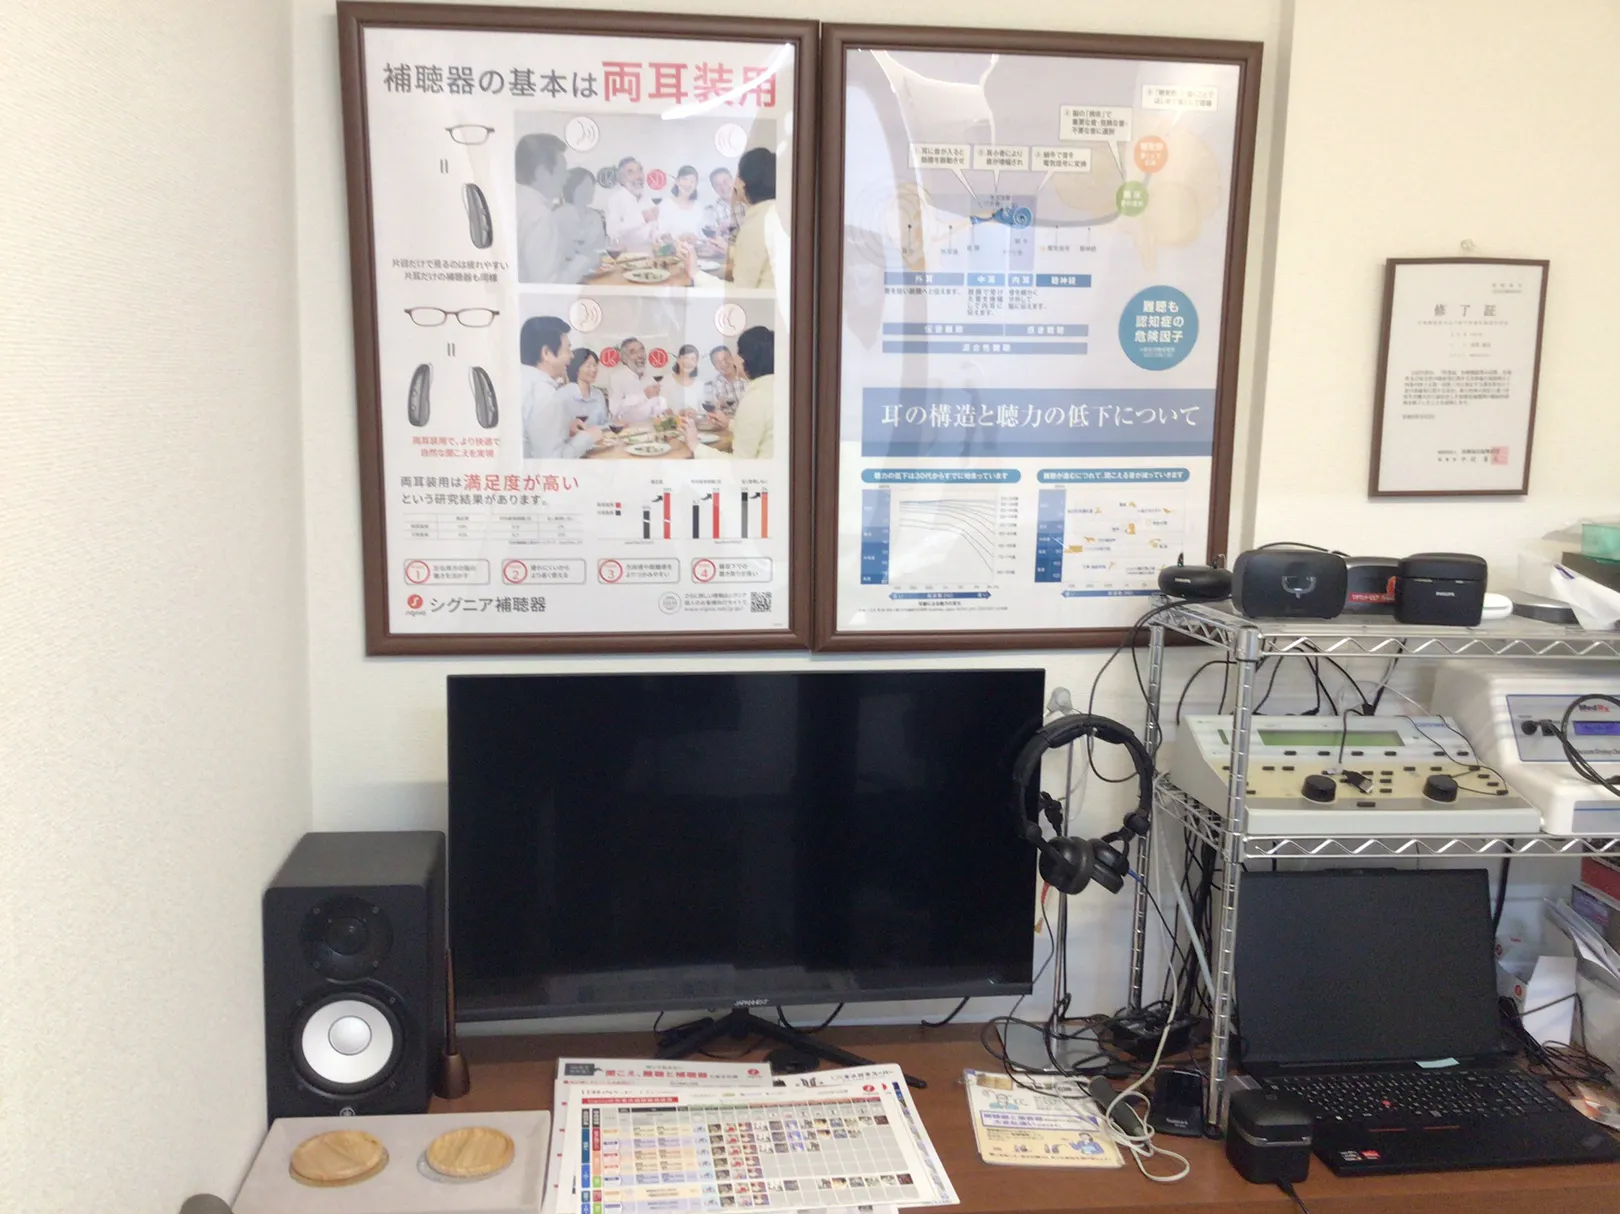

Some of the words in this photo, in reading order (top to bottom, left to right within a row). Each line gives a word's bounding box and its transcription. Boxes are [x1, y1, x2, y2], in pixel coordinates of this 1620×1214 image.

[383, 61, 777, 108] 補聴器の基本は両耳装用
[1143, 300, 1179, 313] 難聴も
[1135, 315, 1185, 328] 認知症の
[1134, 330, 1184, 343] 危険因子
[881, 404, 1200, 429] 耳の構造と聴力の低下について
[400, 474, 580, 492] 両耳装用は満足度が高い
[401, 494, 549, 506] という研究結果があります。
[512, 570, 520, 580] 2
[608, 569, 616, 580] 3
[701, 568, 709, 578] 4
[430, 597, 546, 613] シグニア補聴器
